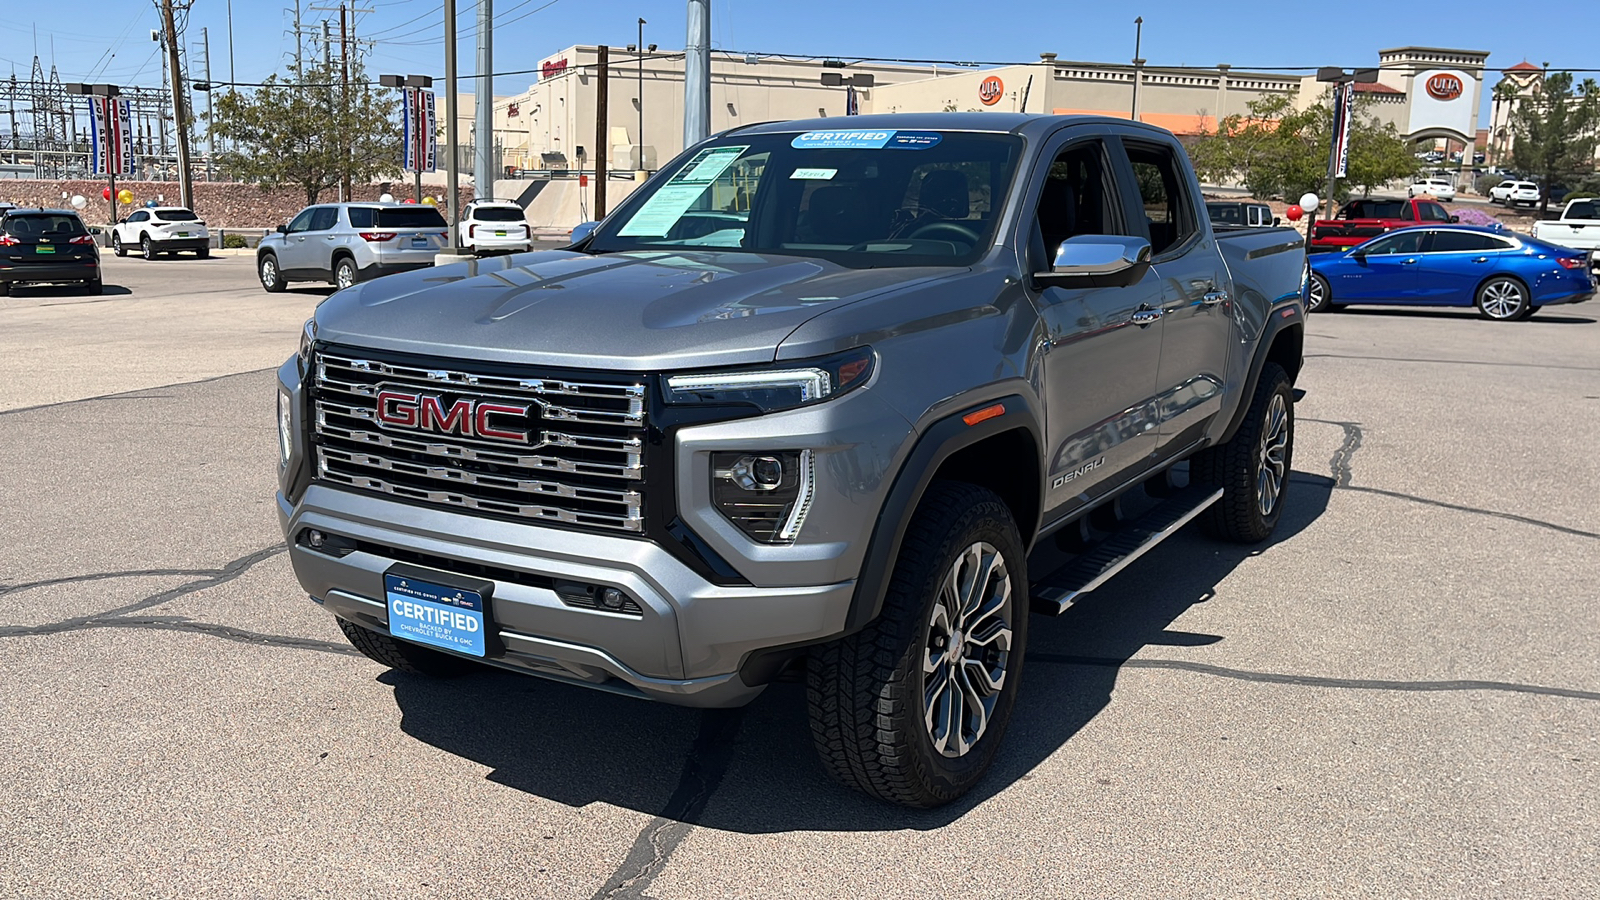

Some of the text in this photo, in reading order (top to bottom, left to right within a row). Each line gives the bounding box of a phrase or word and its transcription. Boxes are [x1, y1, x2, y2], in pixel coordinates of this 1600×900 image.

[981, 81, 1000, 94] ULTA
[1434, 77, 1459, 89] ULTA
[95, 99, 103, 121] LOW
[119, 101, 128, 122] LOW
[377, 390, 530, 444] GMC
[1052, 456, 1105, 490] DENALI
[393, 599, 479, 632] CERTIFIED
[400, 623, 434, 637] CHEVROLET
[435, 631, 453, 642] BUICK
[459, 638, 473, 646] GMC
[419, 622, 452, 635] BACKED BY
